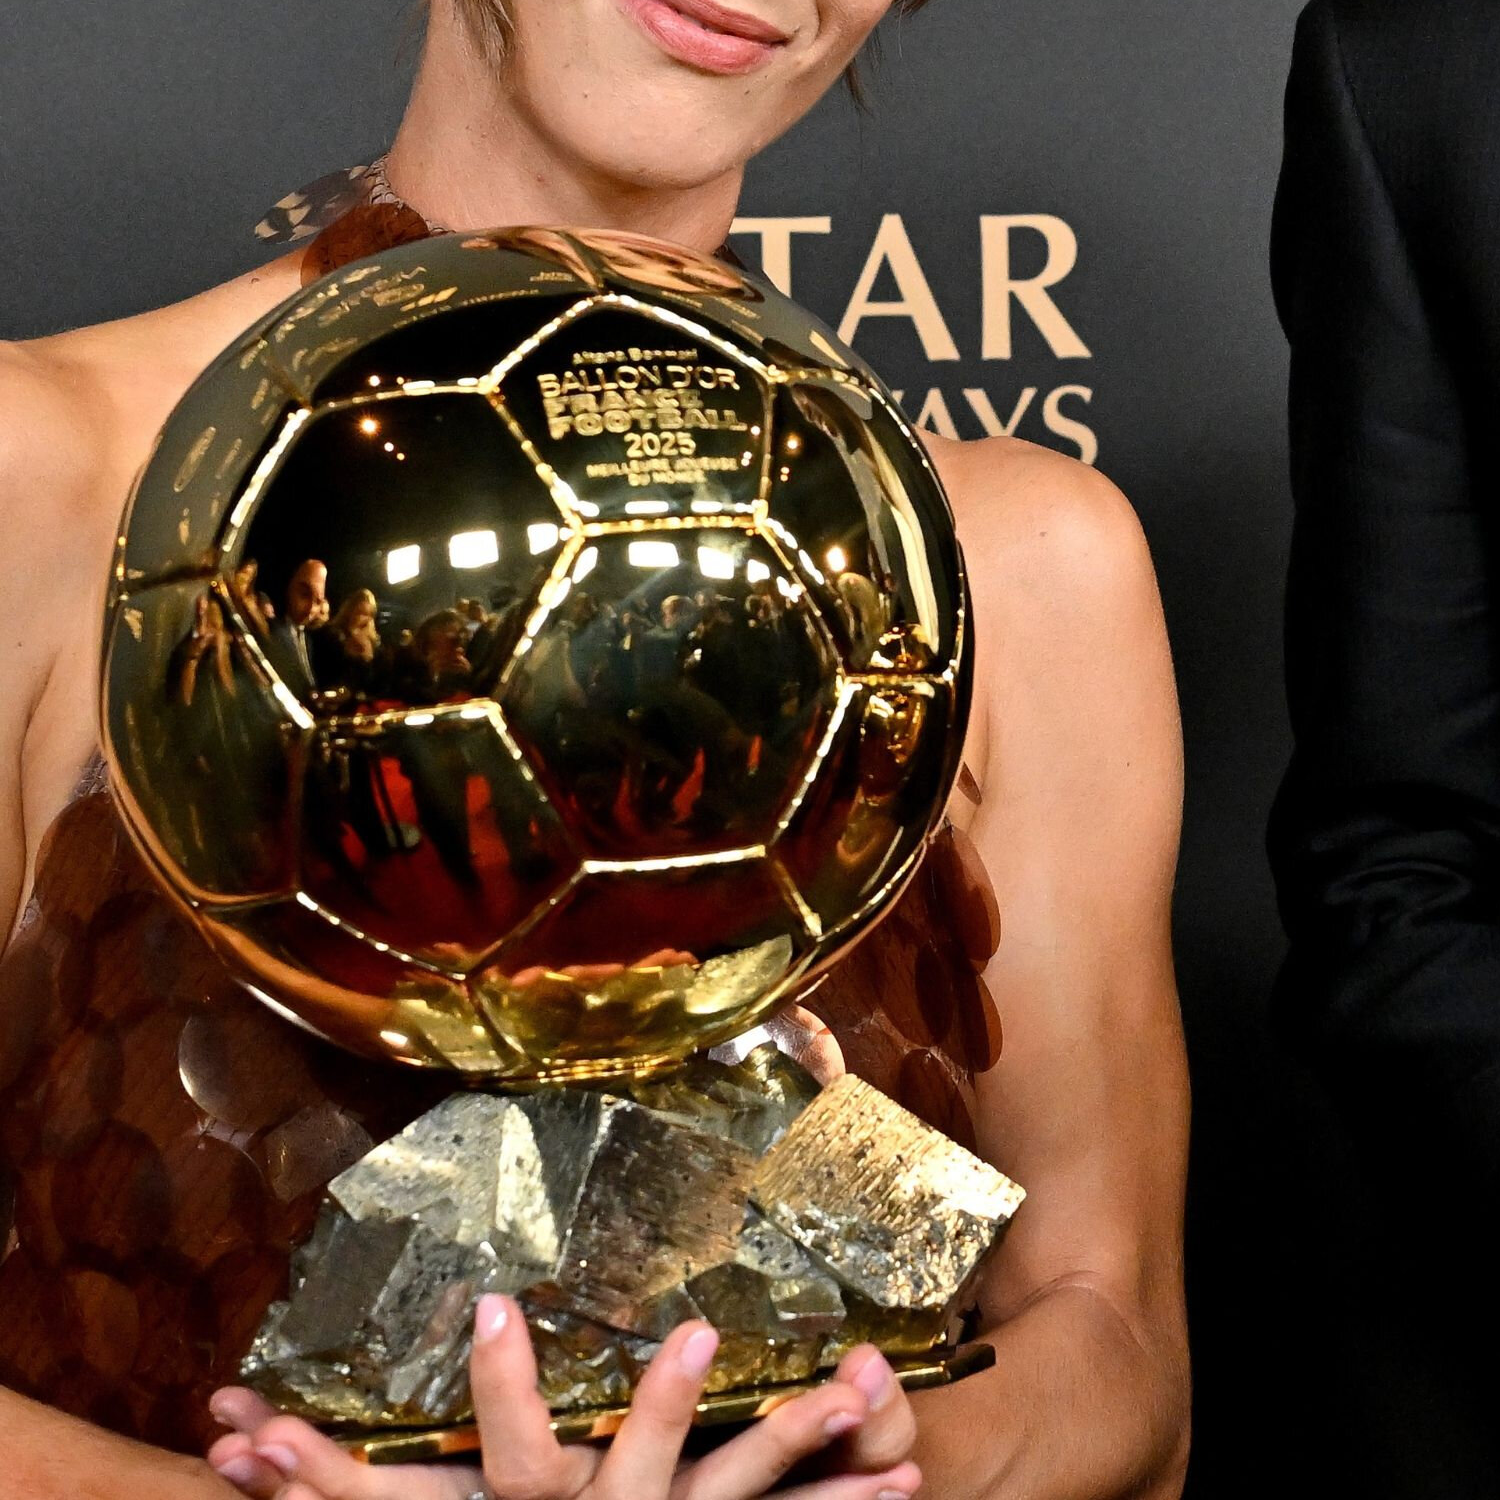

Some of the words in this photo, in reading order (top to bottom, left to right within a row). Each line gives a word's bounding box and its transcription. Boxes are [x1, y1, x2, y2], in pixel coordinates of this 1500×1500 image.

[537, 365, 662, 398] BALLON
[666, 366, 740, 391] D'OR
[543, 388, 704, 419] FRANCE
[548, 408, 748, 440] FOOTBALL
[892, 384, 1098, 466] AYS
[623, 431, 696, 458] 2025
